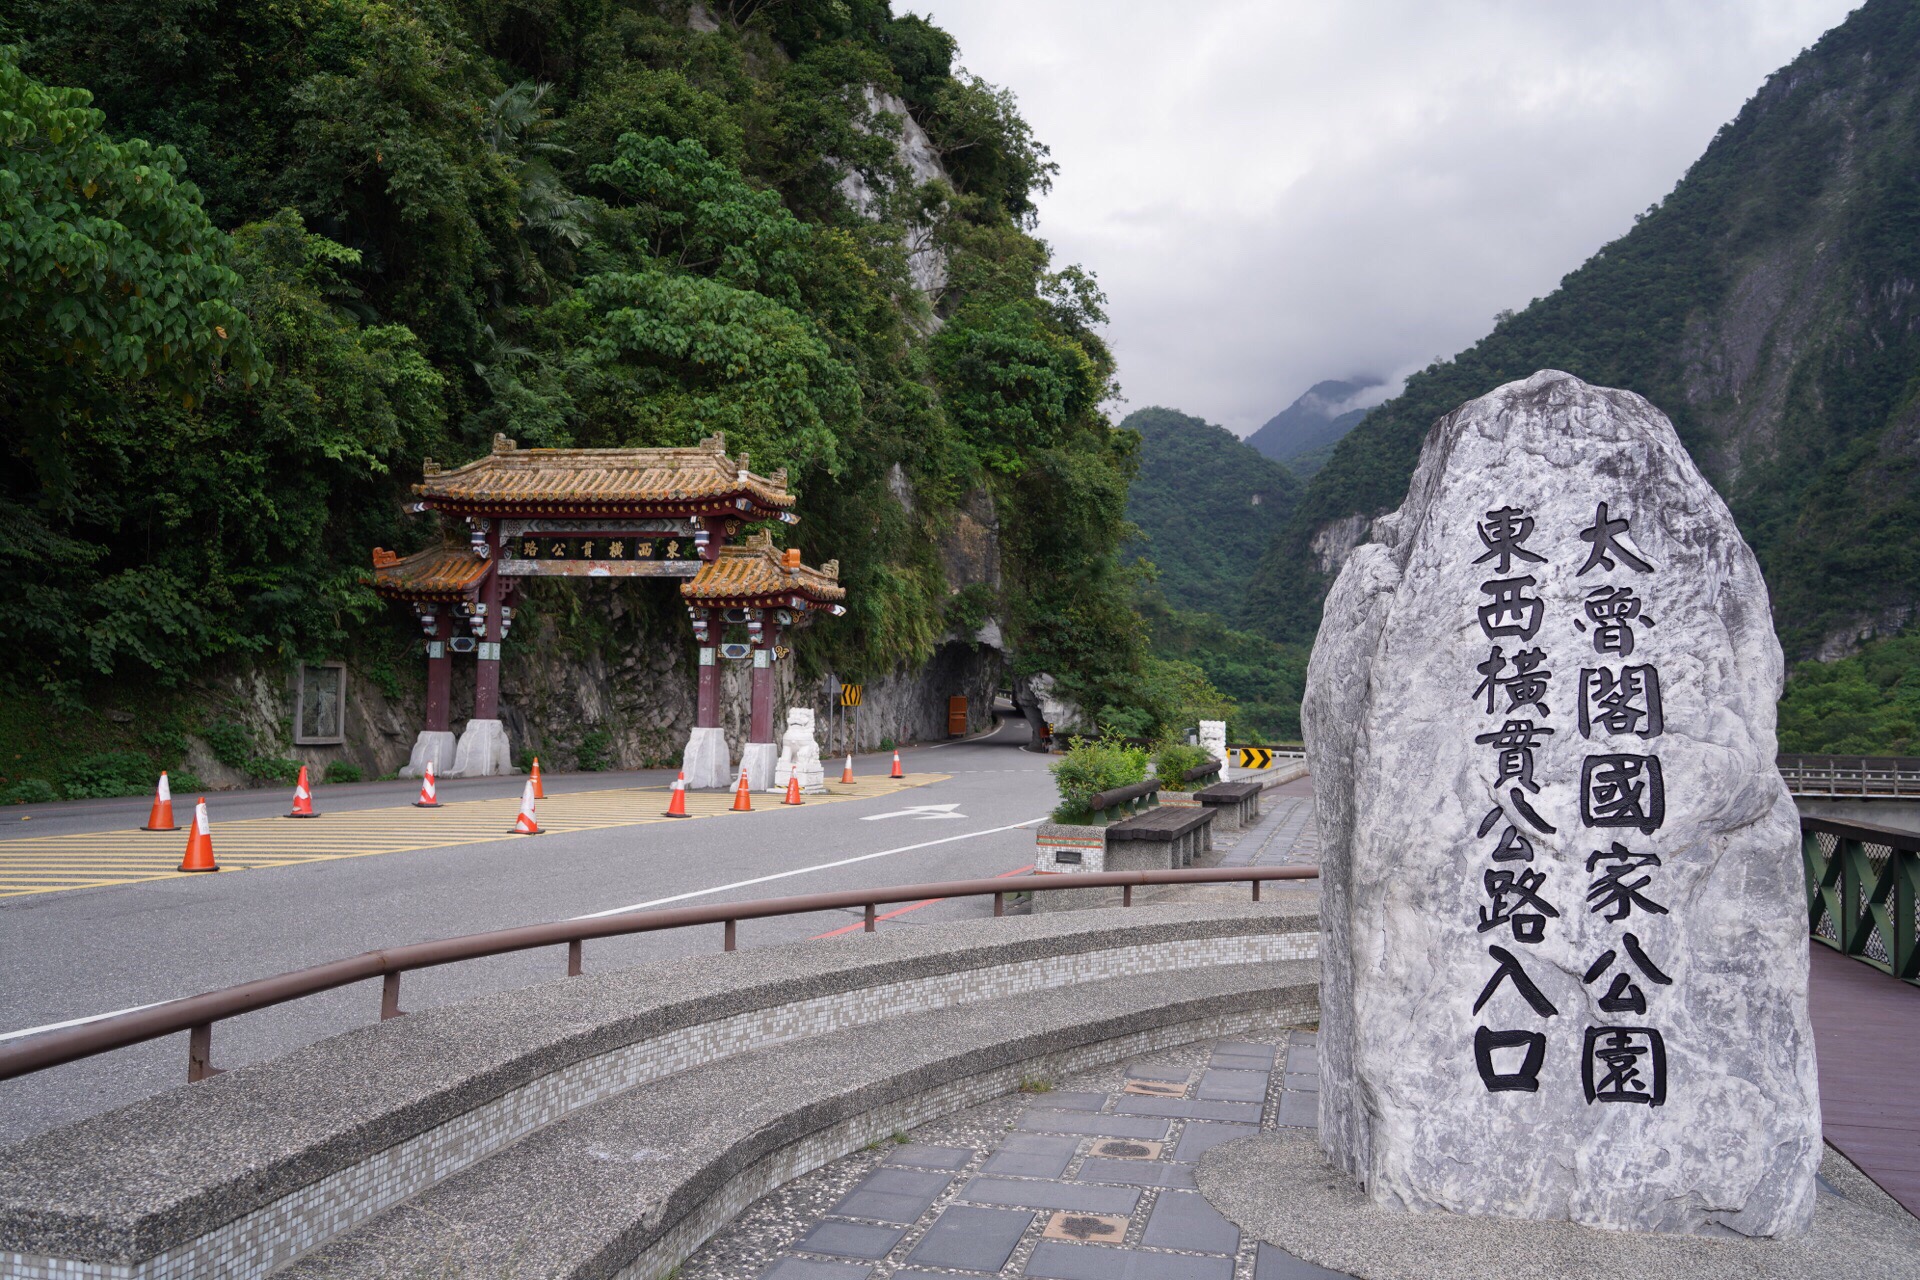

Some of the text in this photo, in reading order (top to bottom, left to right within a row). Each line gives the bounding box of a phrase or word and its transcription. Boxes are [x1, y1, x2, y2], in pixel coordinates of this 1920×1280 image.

[1471, 505, 1560, 1093] 東西橫貫公路入口
[1574, 501, 1673, 1108] 太魯閣國家公園
